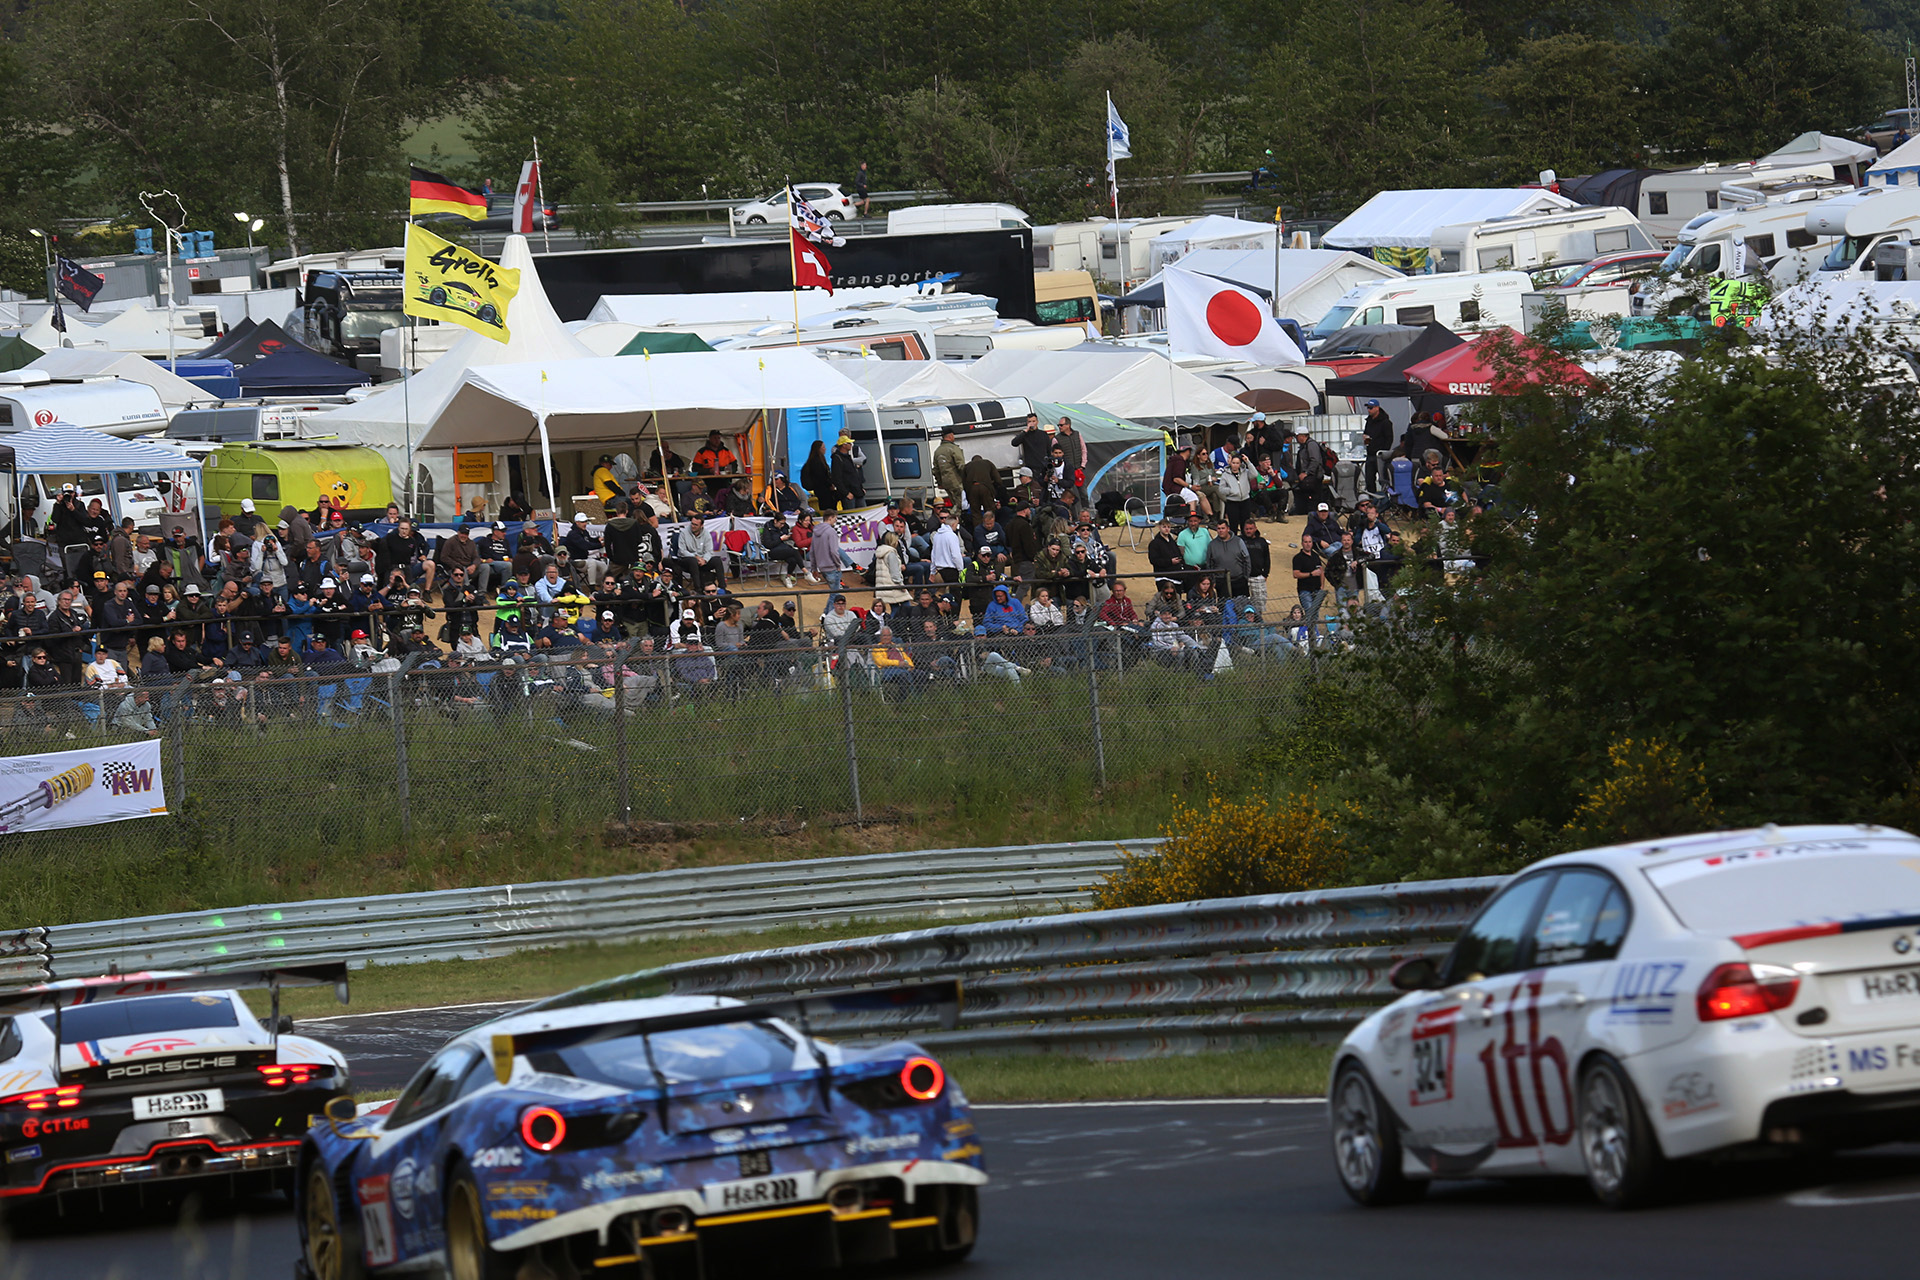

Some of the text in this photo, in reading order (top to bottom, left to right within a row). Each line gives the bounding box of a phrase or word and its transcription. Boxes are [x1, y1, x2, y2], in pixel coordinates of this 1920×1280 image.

[427, 246, 499, 289] Grello
[1449, 382, 1492, 395] REWE
[839, 520, 879, 544] KW
[112, 767, 155, 796] KW
[1862, 974, 1913, 999] H&R
[107, 1055, 236, 1079] PORSCHE
[1849, 1047, 1888, 1072] MS
[147, 1096, 183, 1113] H&R
[42, 1117, 90, 1134] CTT.DE
[723, 1181, 769, 1208] H&R
